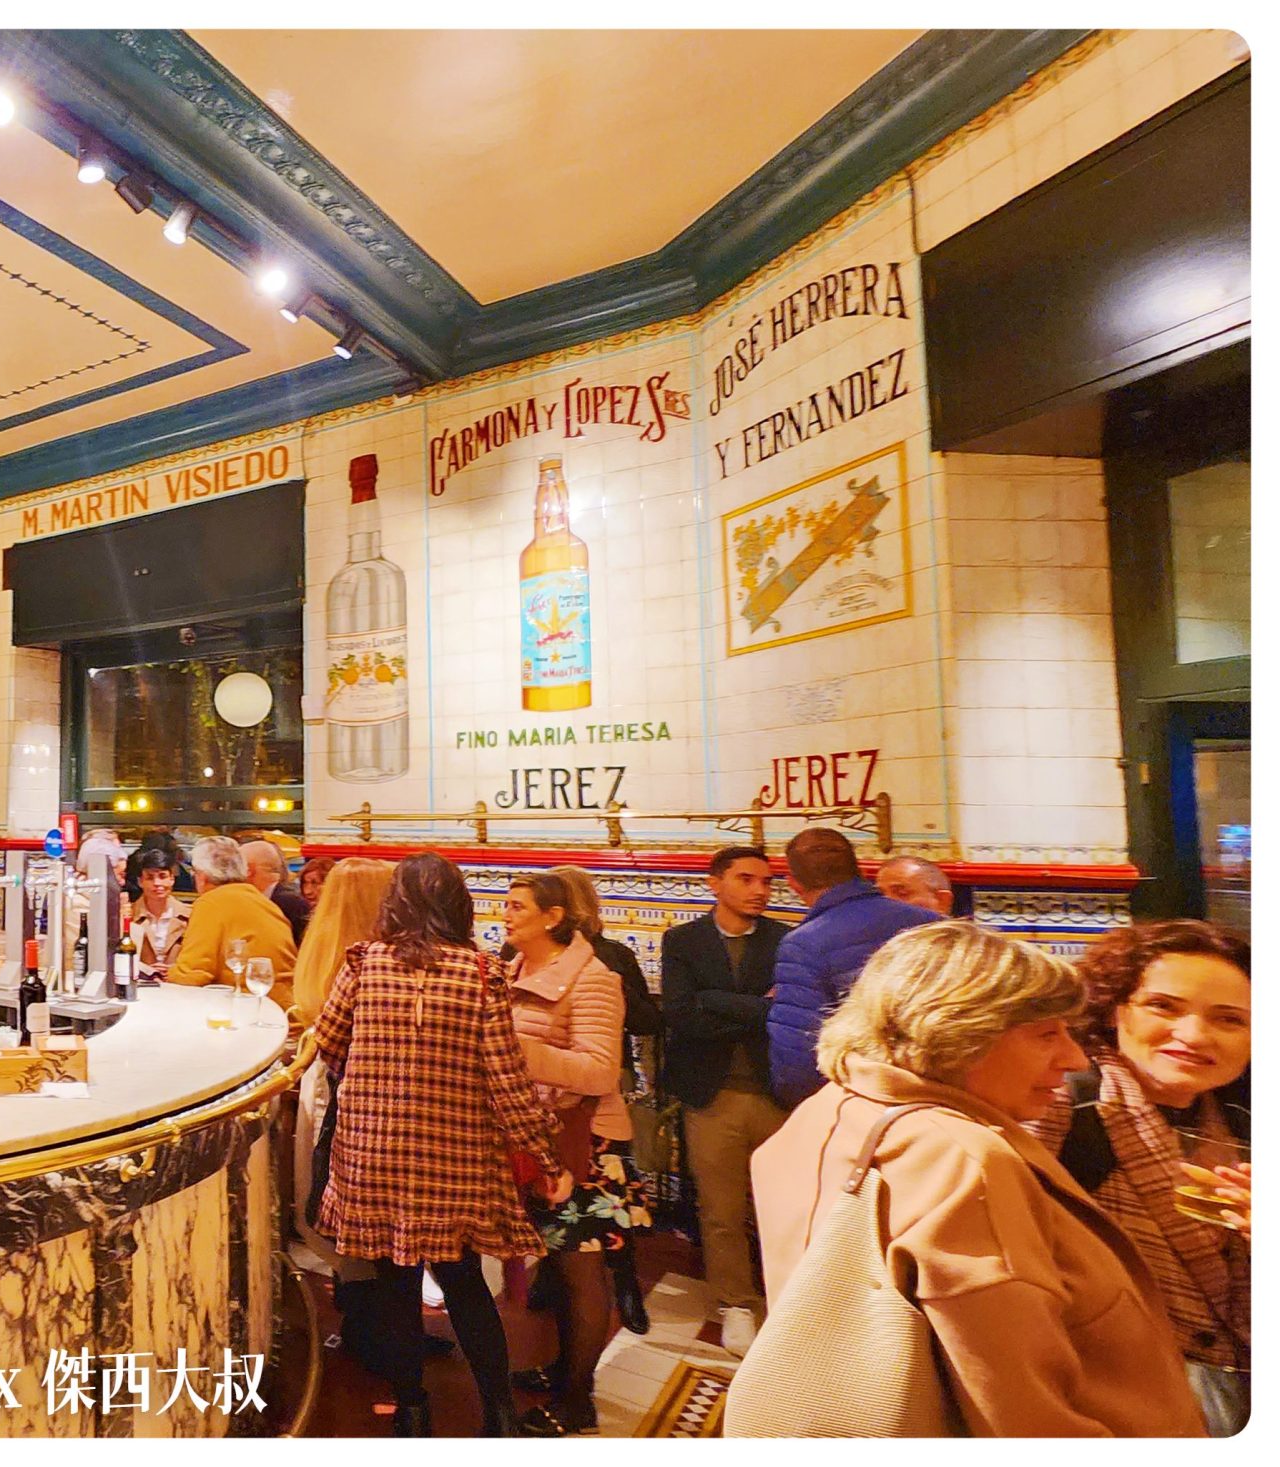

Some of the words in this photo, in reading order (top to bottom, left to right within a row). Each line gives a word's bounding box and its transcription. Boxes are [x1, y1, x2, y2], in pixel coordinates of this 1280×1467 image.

[770, 262, 911, 351] HERRERA
[429, 397, 540, 497] CARMONA
[562, 377, 647, 439] LOPEZ
[714, 437, 731, 480] Y
[742, 348, 908, 469] FERNANDEZ
[23, 507, 44, 538] M.
[51, 479, 149, 532] MARTIN
[165, 445, 289, 504] VISIEDO
[456, 731, 498, 749] FINO
[508, 726, 577, 747] MARIA
[586, 721, 672, 744] TERESA
[759, 748, 881, 808] JEREZ
[494, 765, 629, 809] JEREZ
